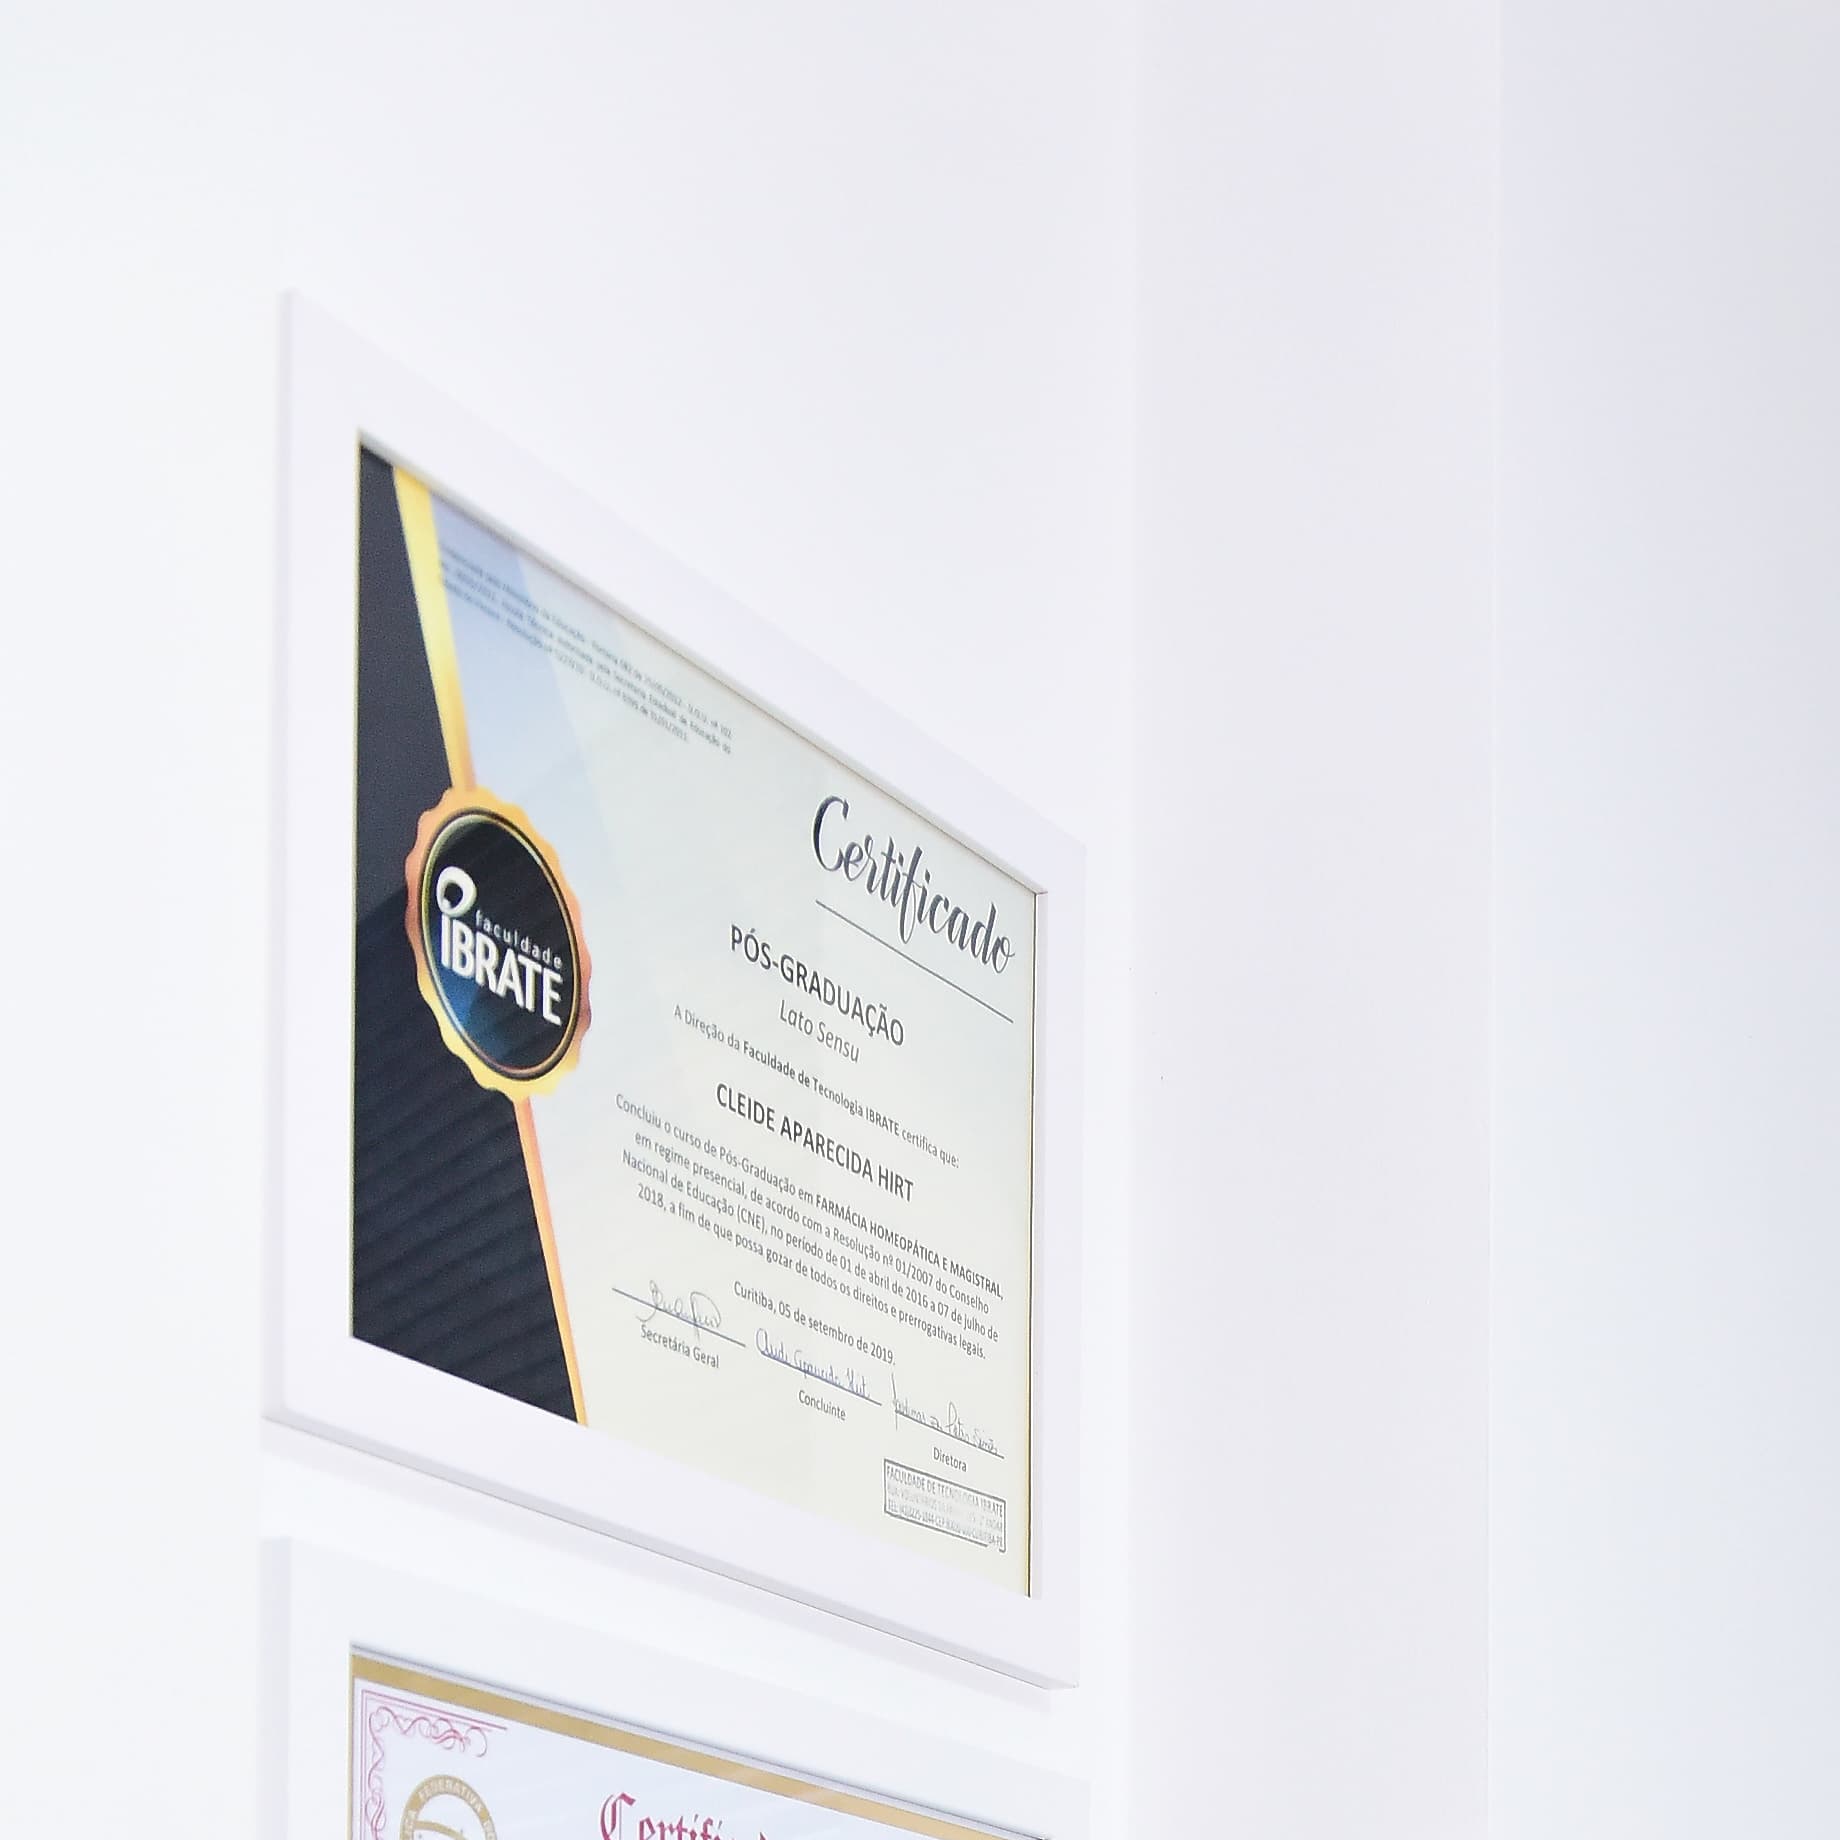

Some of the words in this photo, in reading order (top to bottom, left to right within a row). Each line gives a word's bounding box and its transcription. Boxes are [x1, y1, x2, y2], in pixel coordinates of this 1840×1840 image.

[474, 911, 562, 970] faculdade
[812, 796, 1015, 974] Certificado
[440, 914, 562, 1026] IBRATE
[731, 924, 903, 1046] PÓS-GRADUAÇÃO
[674, 1004, 682, 1020] A
[684, 1009, 724, 1043] Direção
[727, 1033, 740, 1051] da
[743, 1040, 795, 1080] Faculdade
[797, 1069, 810, 1088] de
[811, 1076, 863, 1117] Tecnologia
[865, 1106, 899, 1136] IBRATE
[901, 1129, 937, 1157] certifica
[779, 999, 813, 1036] Lato
[816, 1021, 859, 1063] Sensu
[616, 1094, 661, 1128] Concluiu
[664, 1122, 671, 1133] o
[673, 1126, 701, 1149] curso
[703, 1139, 717, 1157] de
[719, 1146, 796, 1196] Pós-Graduação
[798, 1188, 813, 1205] em
[815, 1194, 867, 1232] FARMÁCIA
[869, 1220, 940, 1268] HOMEOPÁTICA
[942, 1256, 947, 1271] E
[949, 1260, 1003, 1301] MAGISTRAL,
[716, 1083, 775, 1132] CLEIDE
[780, 1115, 873, 1182] APARECIDA
[878, 1164, 913, 1202] HIRT
[635, 1132, 651, 1150] em
[654, 1142, 690, 1170] regime
[692, 1162, 747, 1200] presencial,
[750, 1187, 763, 1206] de
[765, 1197, 800, 1223] acordo
[801, 1215, 822, 1234] com
[824, 1226, 830, 1239] a
[833, 1227, 880, 1262] Resolução
[895, 1257, 933, 1287] 01/2007
[935, 1277, 947, 1295] do
[949, 1284, 989, 1314] Conselho
[638, 1182, 666, 1212] 2018,
[669, 1201, 675, 1214] a
[678, 1201, 695, 1223] fim
[697, 1213, 710, 1231] de
[713, 1223, 733, 1242] que
[735, 1233, 763, 1256] possa
[766, 1248, 793, 1269] gozar
[795, 1258, 808, 1277] de
[810, 1266, 837, 1290] todos
[839, 1282, 850, 1297] os
[852, 1285, 888, 1314] direitos
[890, 1306, 896, 1318] e
[898, 1309, 957, 1346] prerrogativas
[959, 1333, 986, 1359] legais.
[692, 1346, 719, 1369] Geral
[734, 1280, 776, 1315] Curitiba,
[778, 1300, 791, 1319] 05
[793, 1307, 806, 1326] de
[808, 1317, 854, 1347] setembro
[856, 1335, 868, 1354] de
[870, 1341, 895, 1366] 2019.
[798, 1389, 846, 1421] Concluinte
[933, 1446, 966, 1472] Diretora
